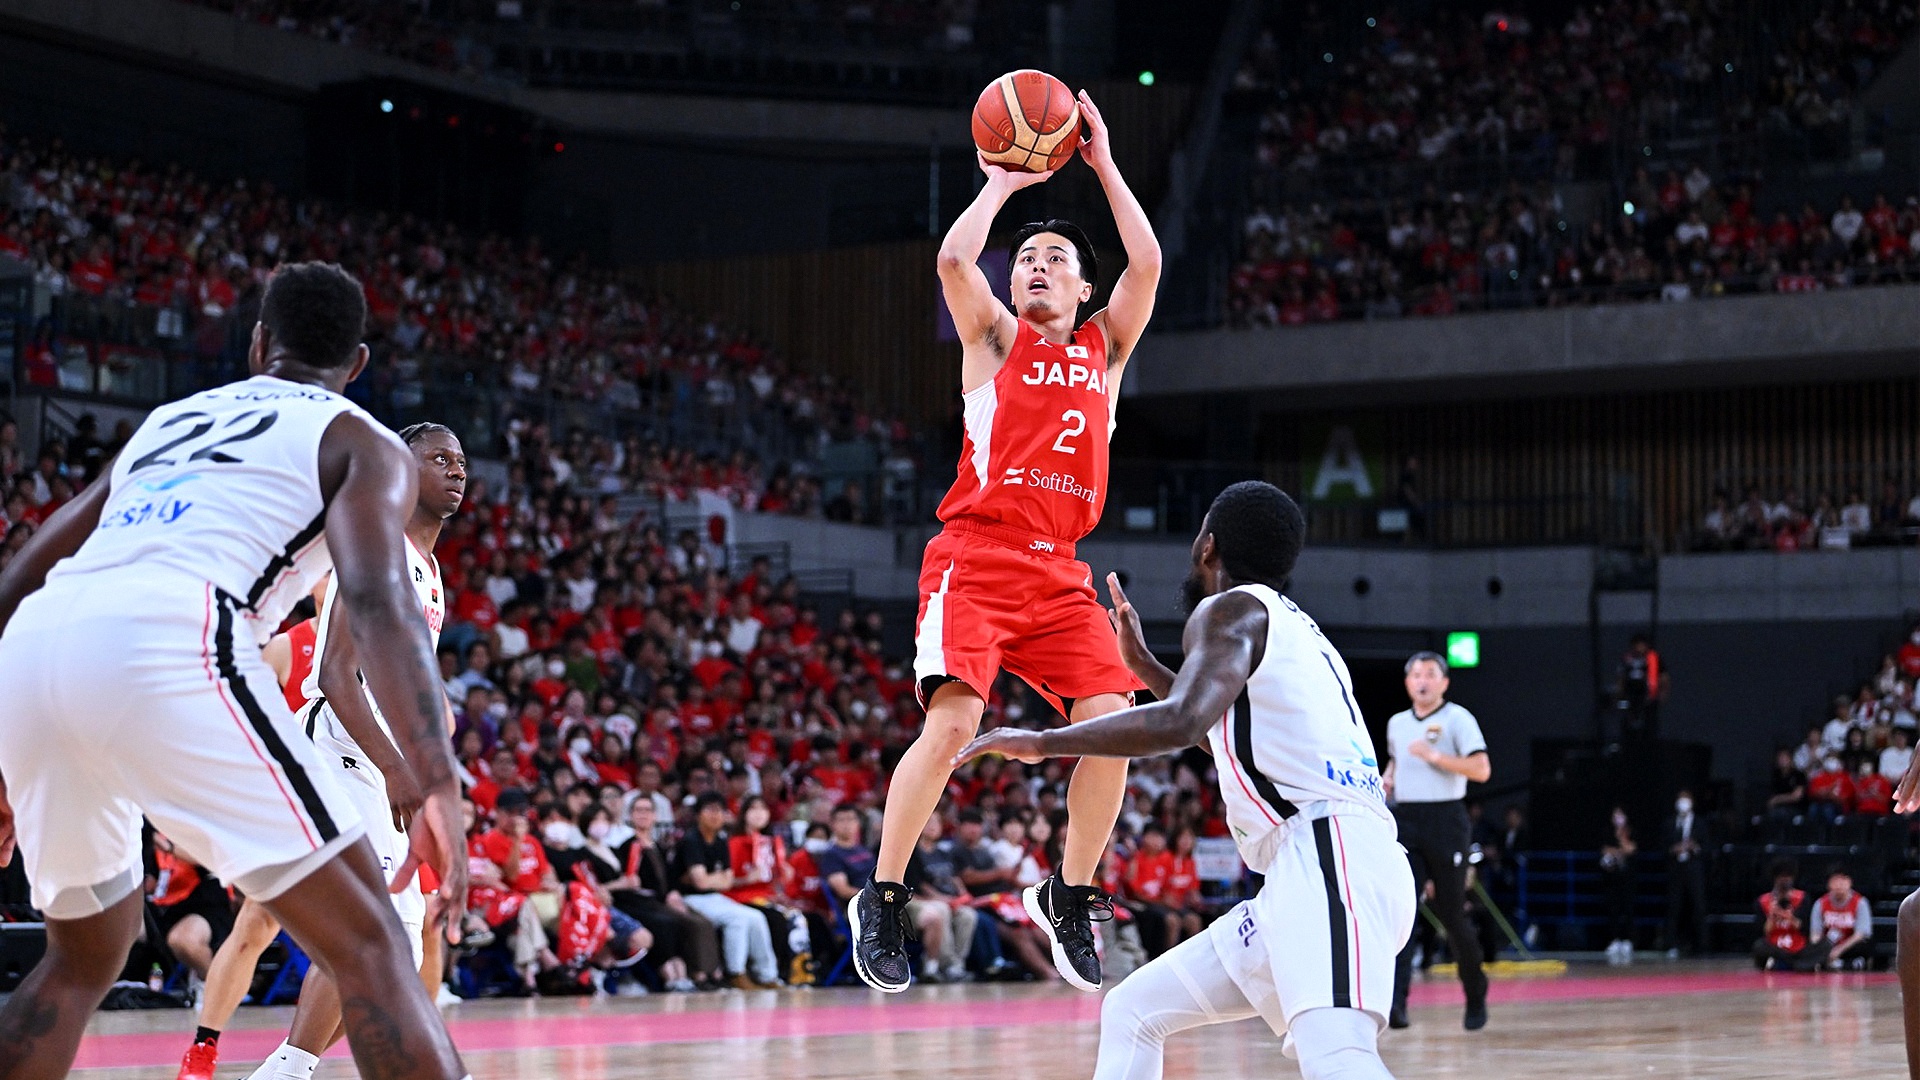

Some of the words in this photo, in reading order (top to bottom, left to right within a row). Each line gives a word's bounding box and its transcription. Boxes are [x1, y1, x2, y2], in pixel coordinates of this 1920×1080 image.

[128, 410, 279, 475] 22
[1052, 409, 1086, 454] 2
[1312, 425, 1373, 499] A
[1029, 540, 1055, 553] JPN
